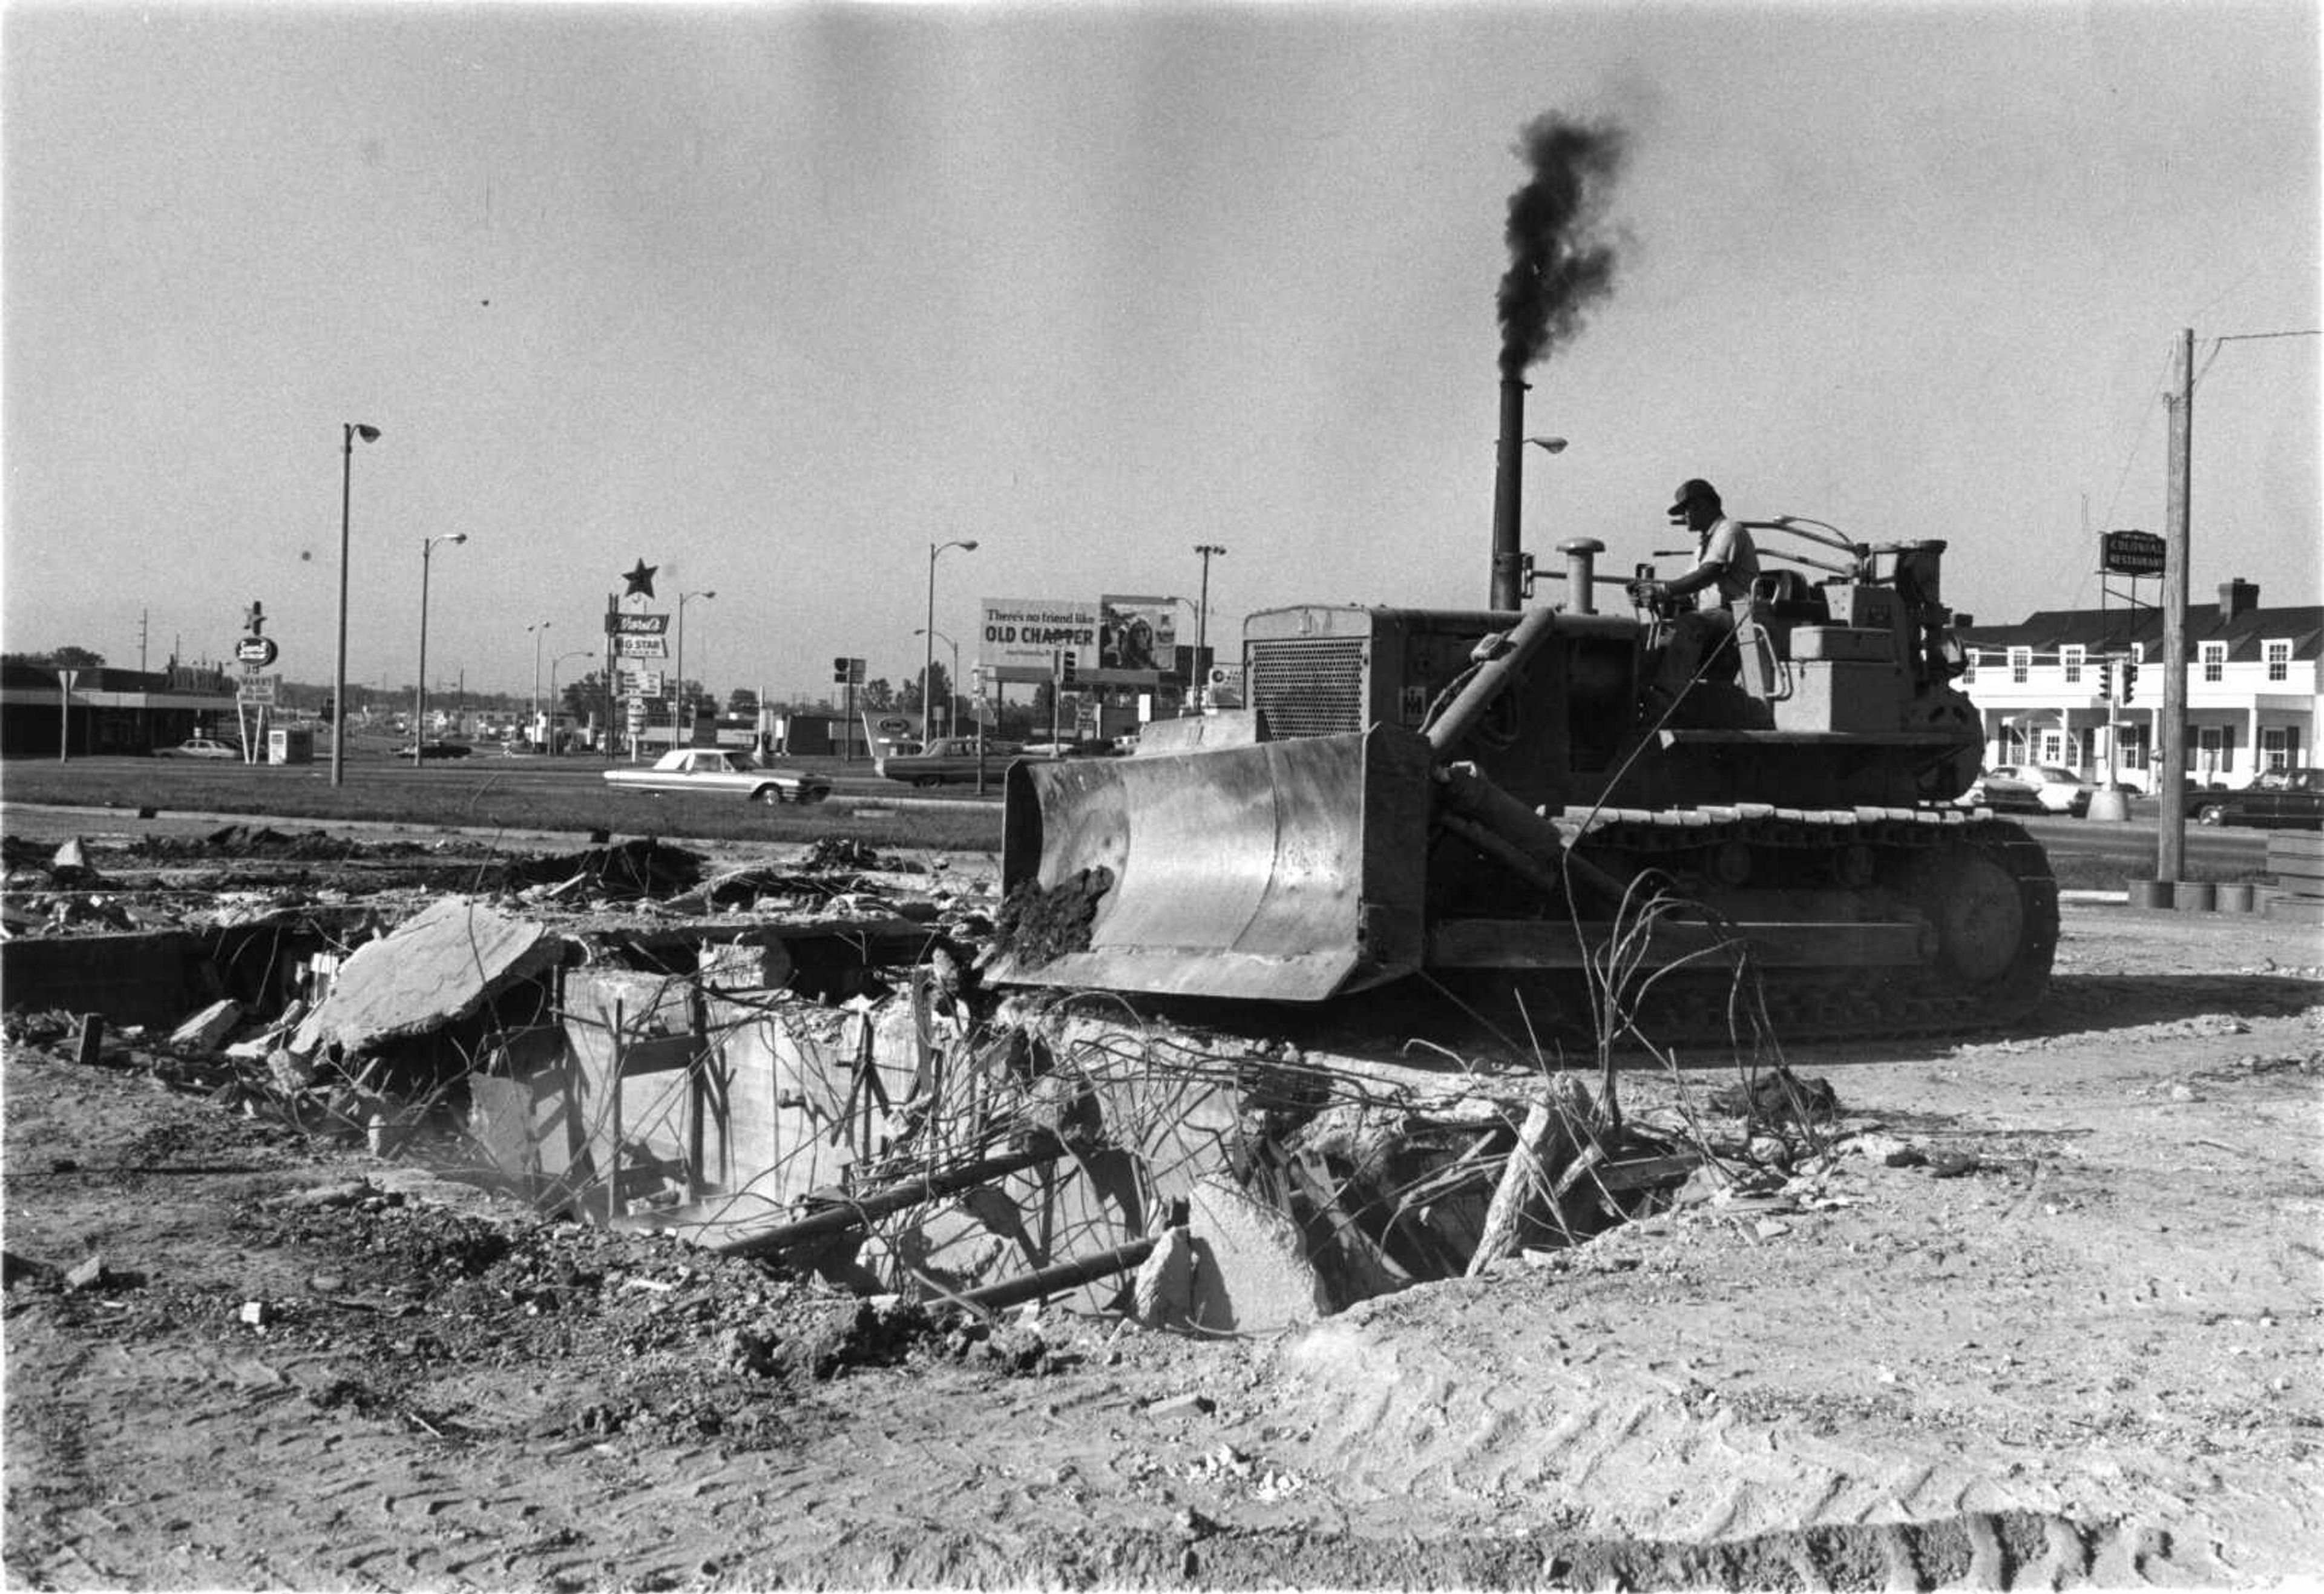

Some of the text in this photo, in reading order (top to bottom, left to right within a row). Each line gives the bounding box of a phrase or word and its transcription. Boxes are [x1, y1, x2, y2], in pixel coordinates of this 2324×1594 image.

[1026, 614, 1040, 622] no
[1042, 612, 1073, 624] friend
[1075, 613, 1095, 624] like
[985, 626, 1016, 642] OLD
[635, 640, 660, 649] STAR
